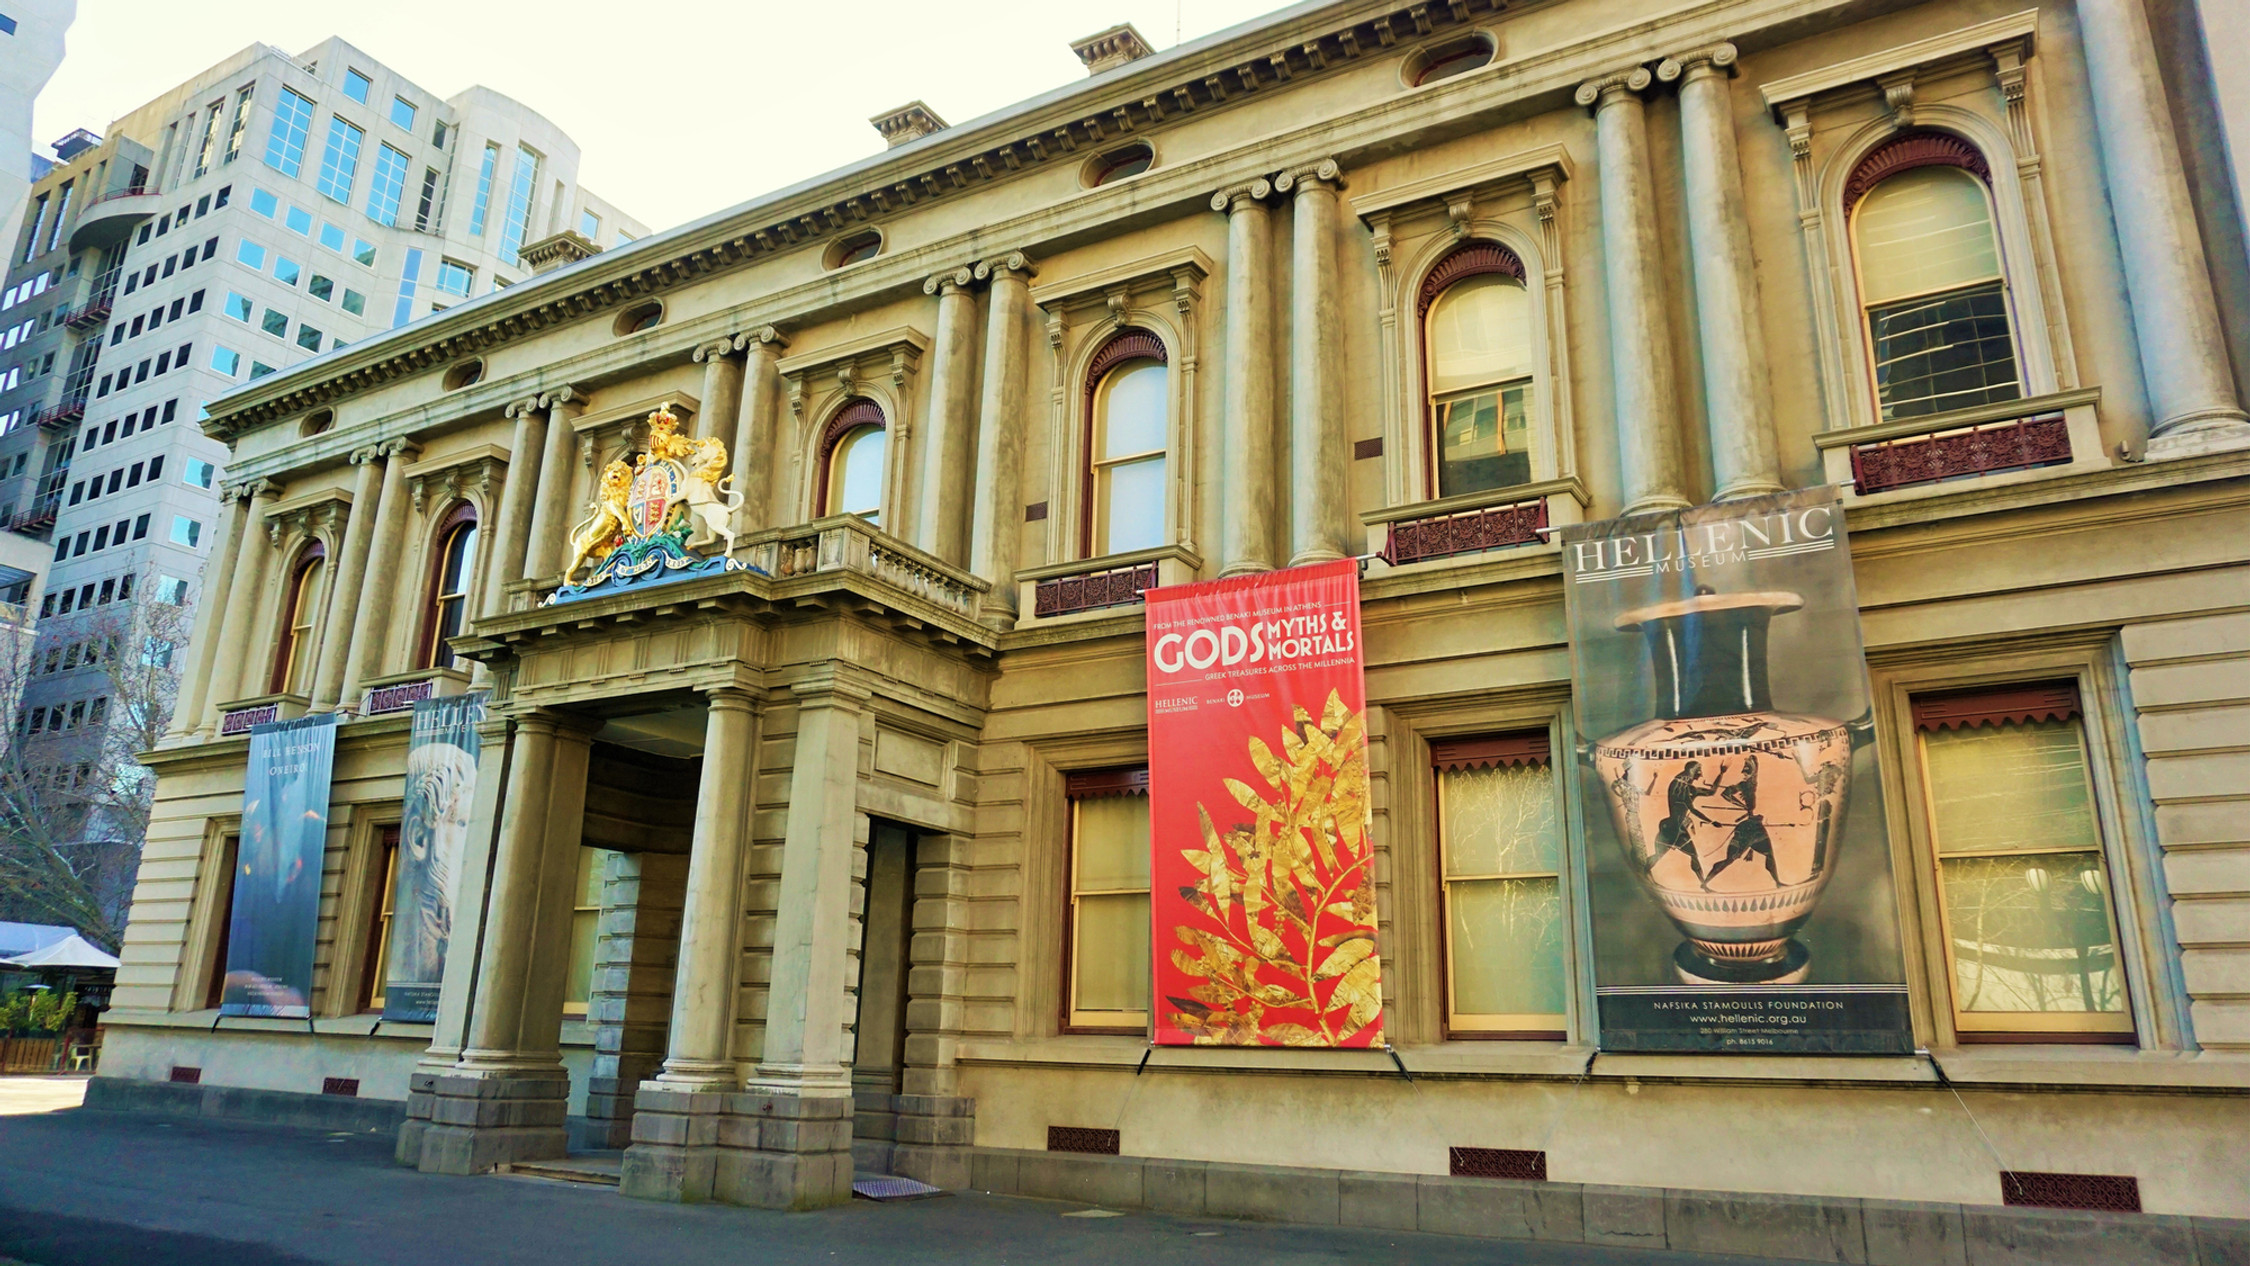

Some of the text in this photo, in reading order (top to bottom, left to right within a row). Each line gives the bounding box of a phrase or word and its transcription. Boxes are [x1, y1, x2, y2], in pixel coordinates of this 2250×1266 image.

[1574, 507, 1834, 573] HELLENIC
[1655, 551, 1747, 574] MUSEUM
[1153, 622, 1171, 630] FROM
[1186, 614, 1225, 626] RENOWNED
[1226, 611, 1251, 621] BENAKI
[1252, 607, 1283, 617] MUSEUM
[1292, 601, 1322, 612] ATHENS
[1267, 611, 1347, 639] MYTHS &
[1154, 621, 1265, 673] GODS
[1267, 631, 1355, 661] MORTALS
[1205, 657, 1355, 680] GREEK TREASURES ACROSS THE MILLENNIA
[1155, 695, 1198, 708] HELLENIC
[1246, 692, 1270, 700] MUSEUM
[1653, 1001, 1844, 1010] NAFSIKA STAMOULIS FOUNDATION
[1689, 1014, 1807, 1025] www.hellenic.org.au
